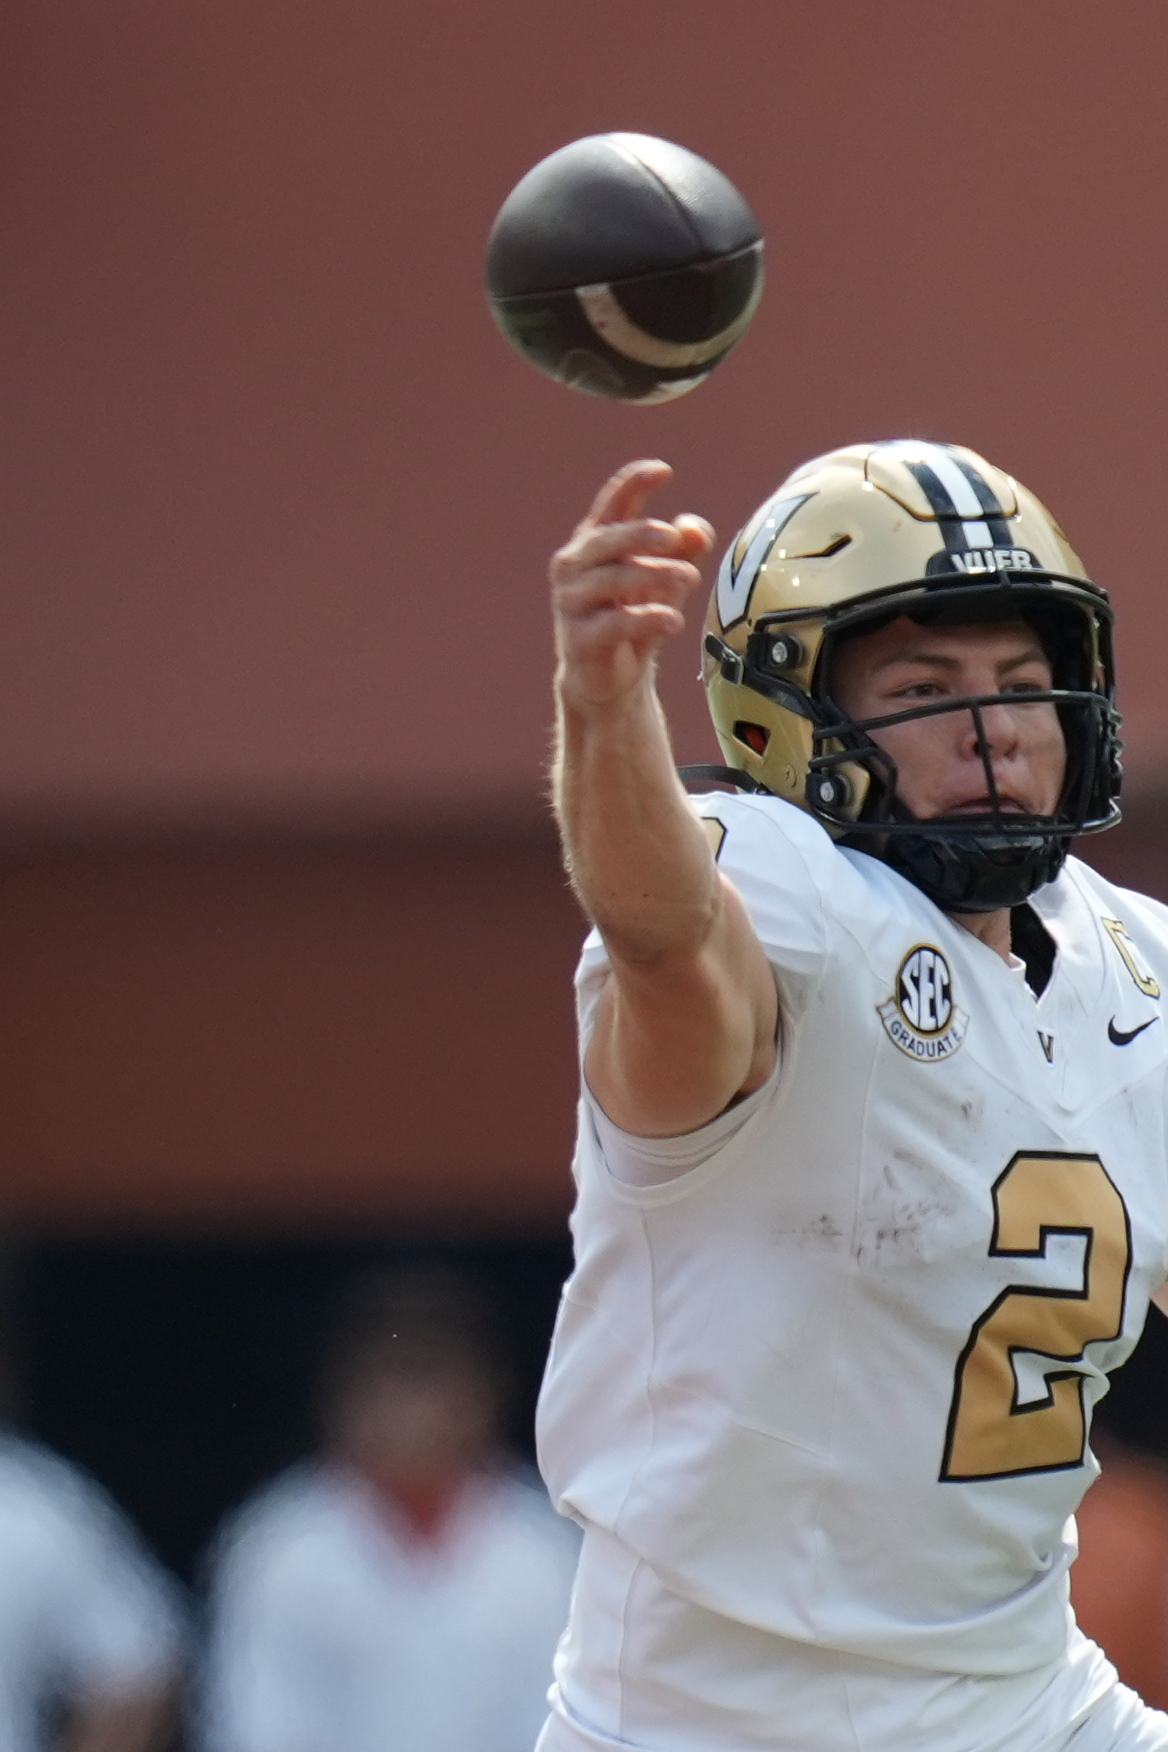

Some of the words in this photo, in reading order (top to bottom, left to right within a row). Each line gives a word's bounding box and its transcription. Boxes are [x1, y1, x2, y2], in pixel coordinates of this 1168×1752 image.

[900, 949, 952, 1031] SEC
[891, 1021, 961, 1057] GRADUATE
[1037, 1030, 1054, 1063] V
[938, 1149, 1133, 1483] 2
